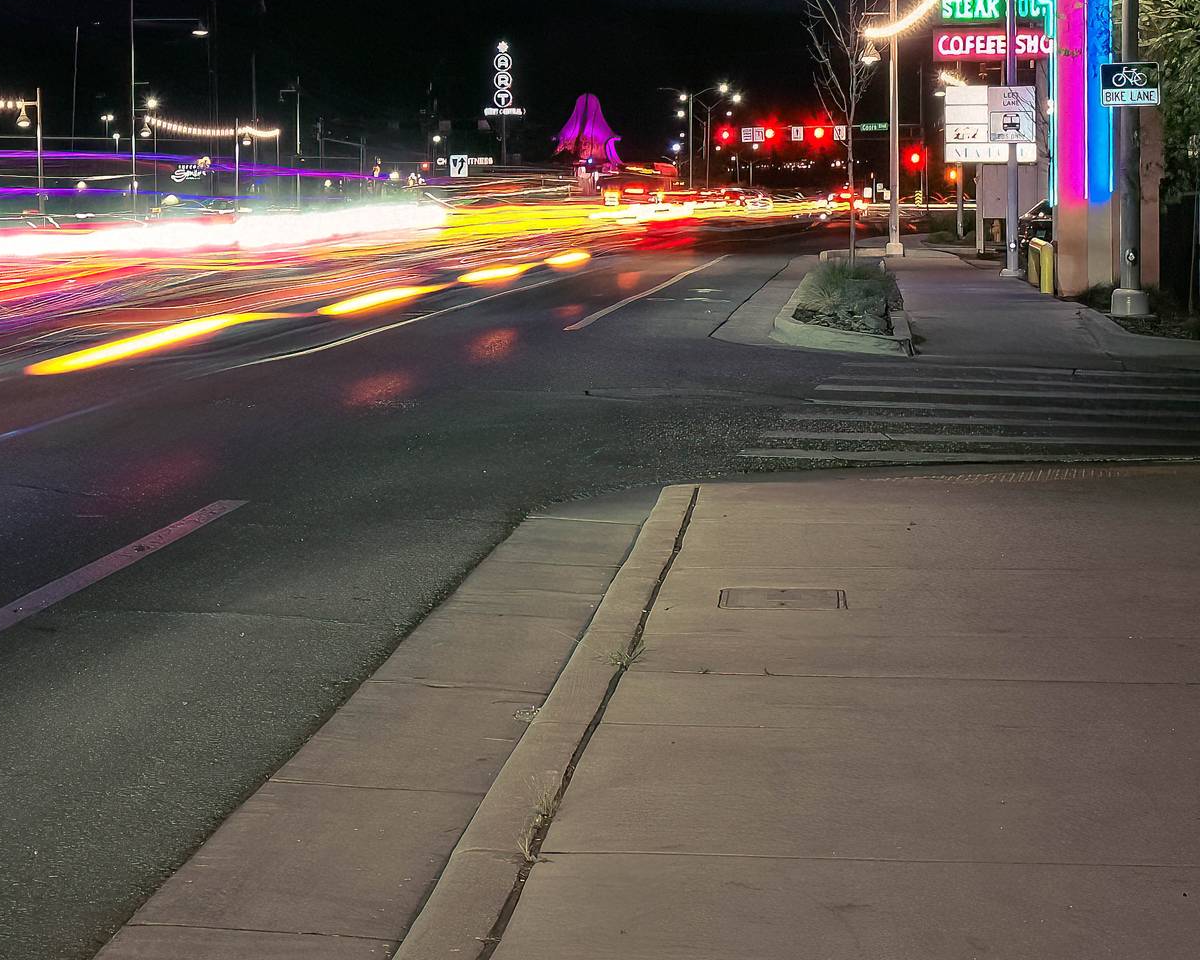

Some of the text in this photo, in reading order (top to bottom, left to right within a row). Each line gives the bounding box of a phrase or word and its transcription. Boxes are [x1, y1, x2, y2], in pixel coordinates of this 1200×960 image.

[1015, 35, 1054, 55] SHO
[1105, 91, 1155, 102] BIKE LANE
